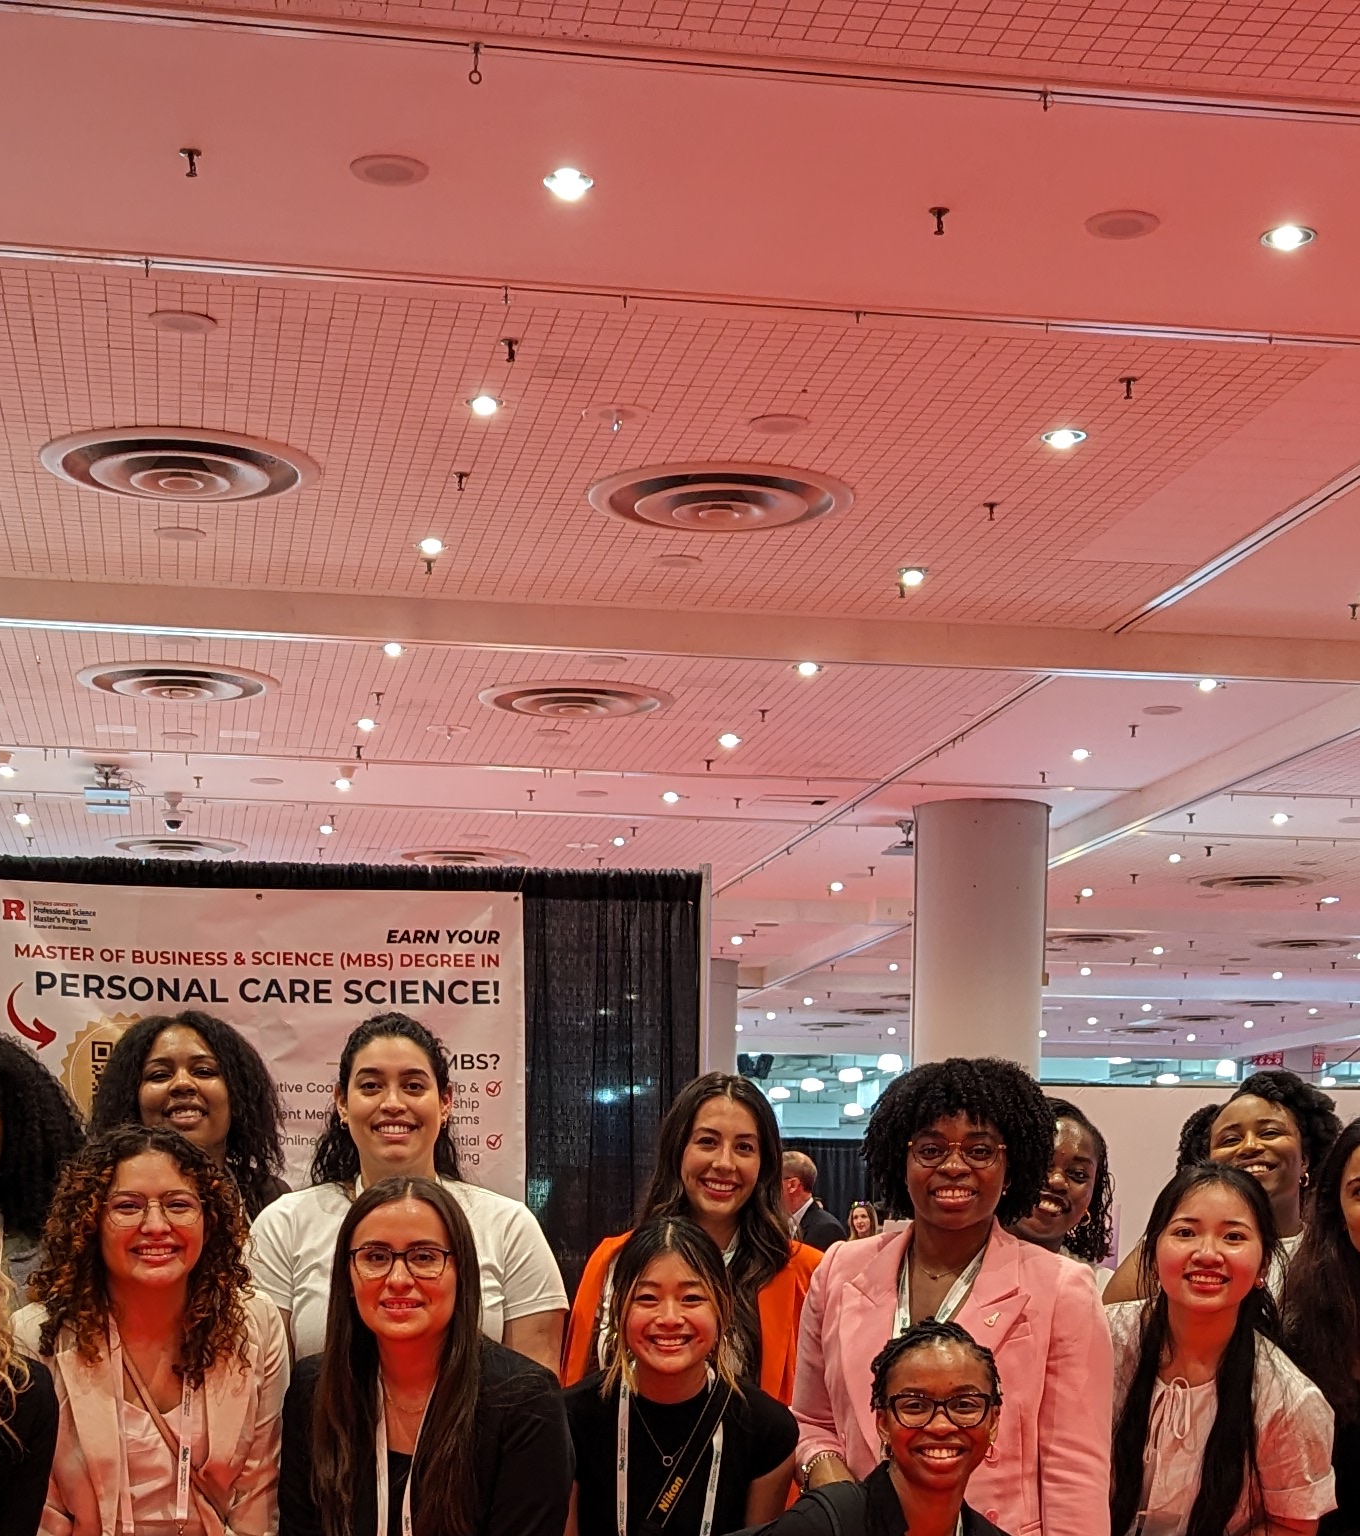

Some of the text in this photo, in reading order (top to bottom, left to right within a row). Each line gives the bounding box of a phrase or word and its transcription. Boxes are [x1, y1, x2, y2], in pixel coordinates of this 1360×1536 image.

[2, 899, 26, 921] R
[33, 906, 97, 917] Professional Science
[33, 915, 88, 927] Master's Program
[386, 930, 501, 945] EARN YOUR
[14, 944, 500, 971] MASTER OF BUSINESS & SCIENCE (MBS) DEGREE IN
[36, 970, 501, 1005] PERSONAL CARE SCIENCE!
[306, 1082, 334, 1094] Coa
[470, 1083, 480, 1094] &
[452, 1098, 480, 1112] ship
[280, 1109, 302, 1120] ent
[452, 1116, 480, 1126] ams
[453, 1135, 480, 1147] ntial
[458, 1151, 480, 1165] ing
[658, 1475, 684, 1513] Nikon
